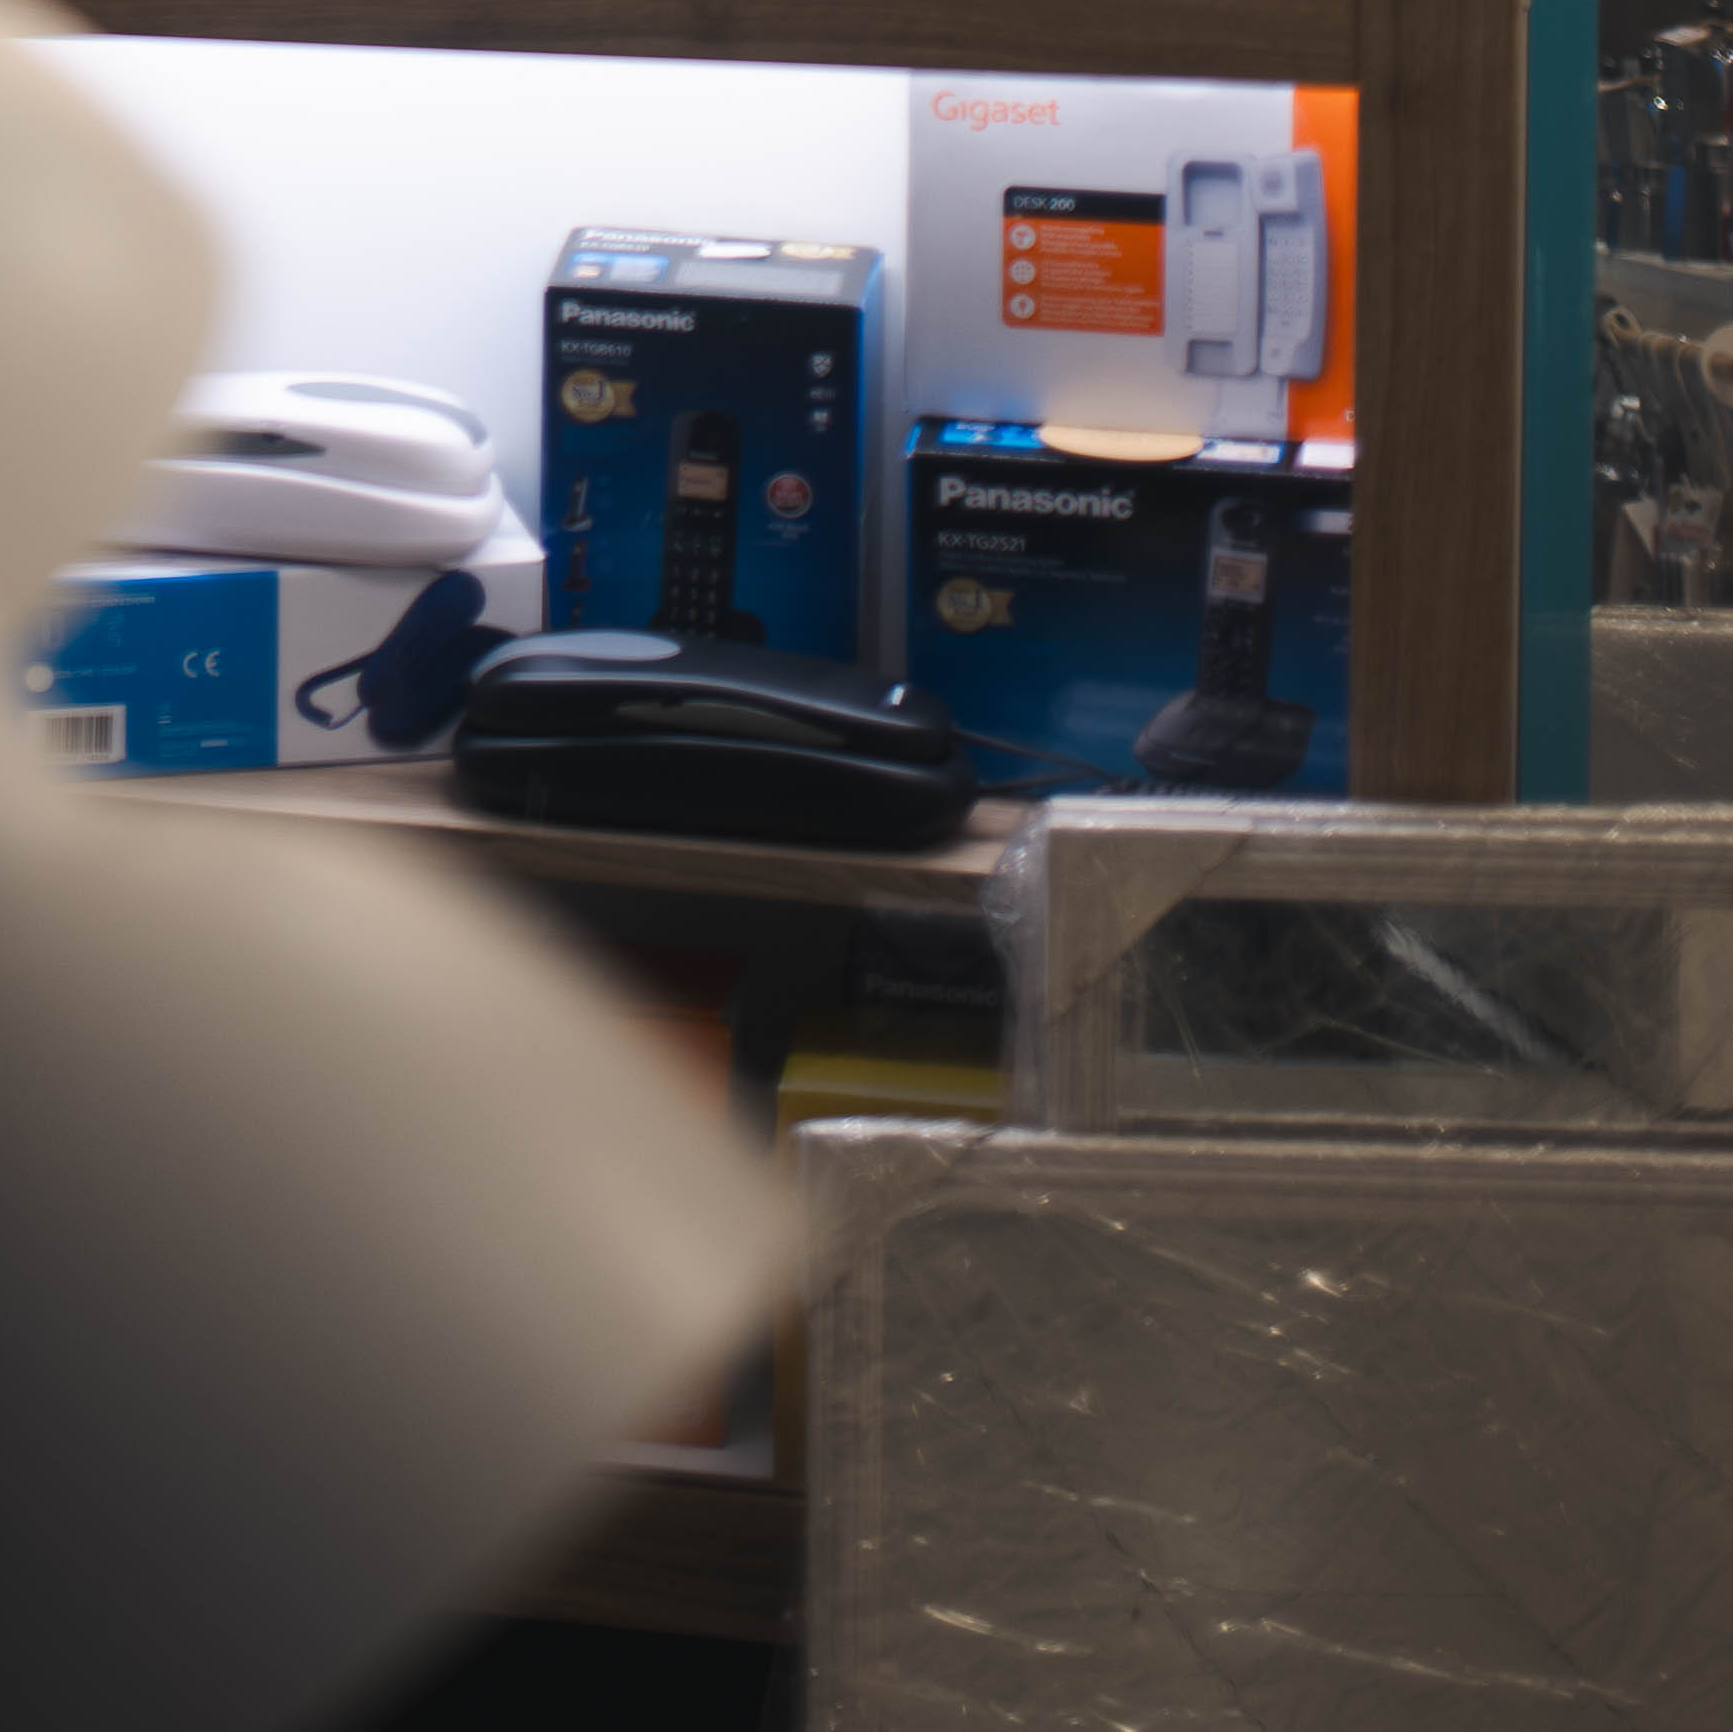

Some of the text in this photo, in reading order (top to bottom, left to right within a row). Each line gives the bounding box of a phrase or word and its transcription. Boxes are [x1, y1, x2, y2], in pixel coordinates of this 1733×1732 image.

[932, 90, 1061, 131] Gigaset
[1013, 195, 1075, 212] DESK 200
[561, 301, 695, 333] Panasonic
[938, 476, 1134, 520] Panasonic
